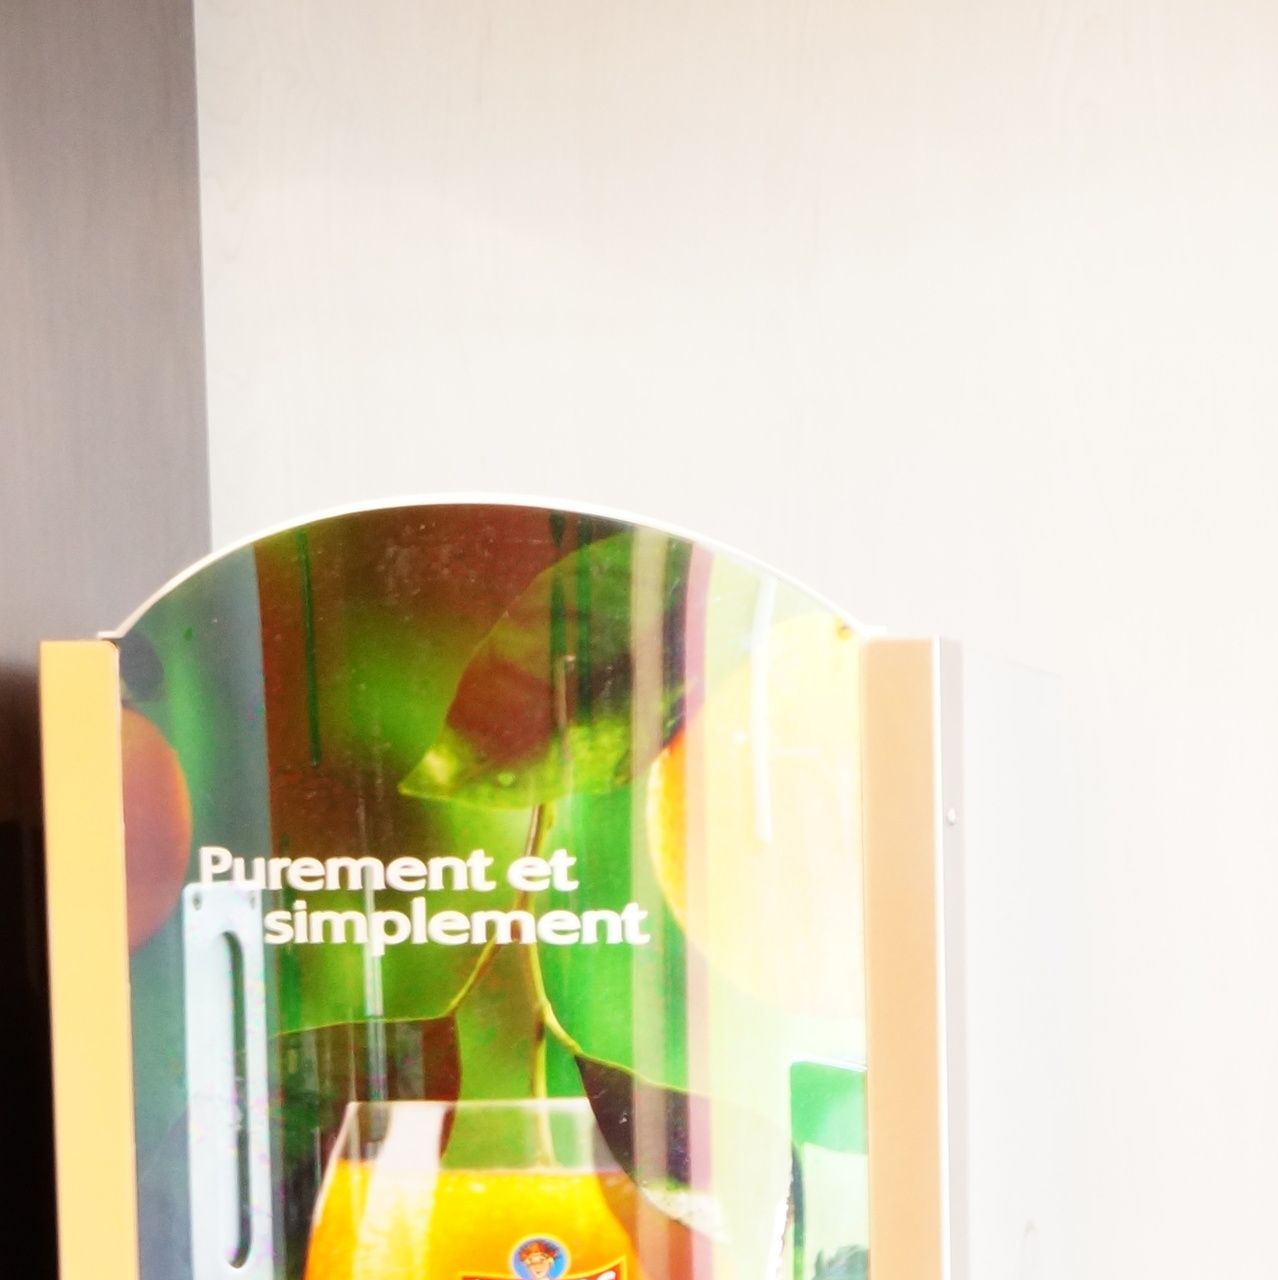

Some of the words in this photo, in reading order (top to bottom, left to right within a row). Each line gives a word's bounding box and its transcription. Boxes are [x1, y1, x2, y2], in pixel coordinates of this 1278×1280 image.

[201, 846, 496, 892] Purement
[507, 849, 579, 892] et
[264, 897, 651, 957] simplement
